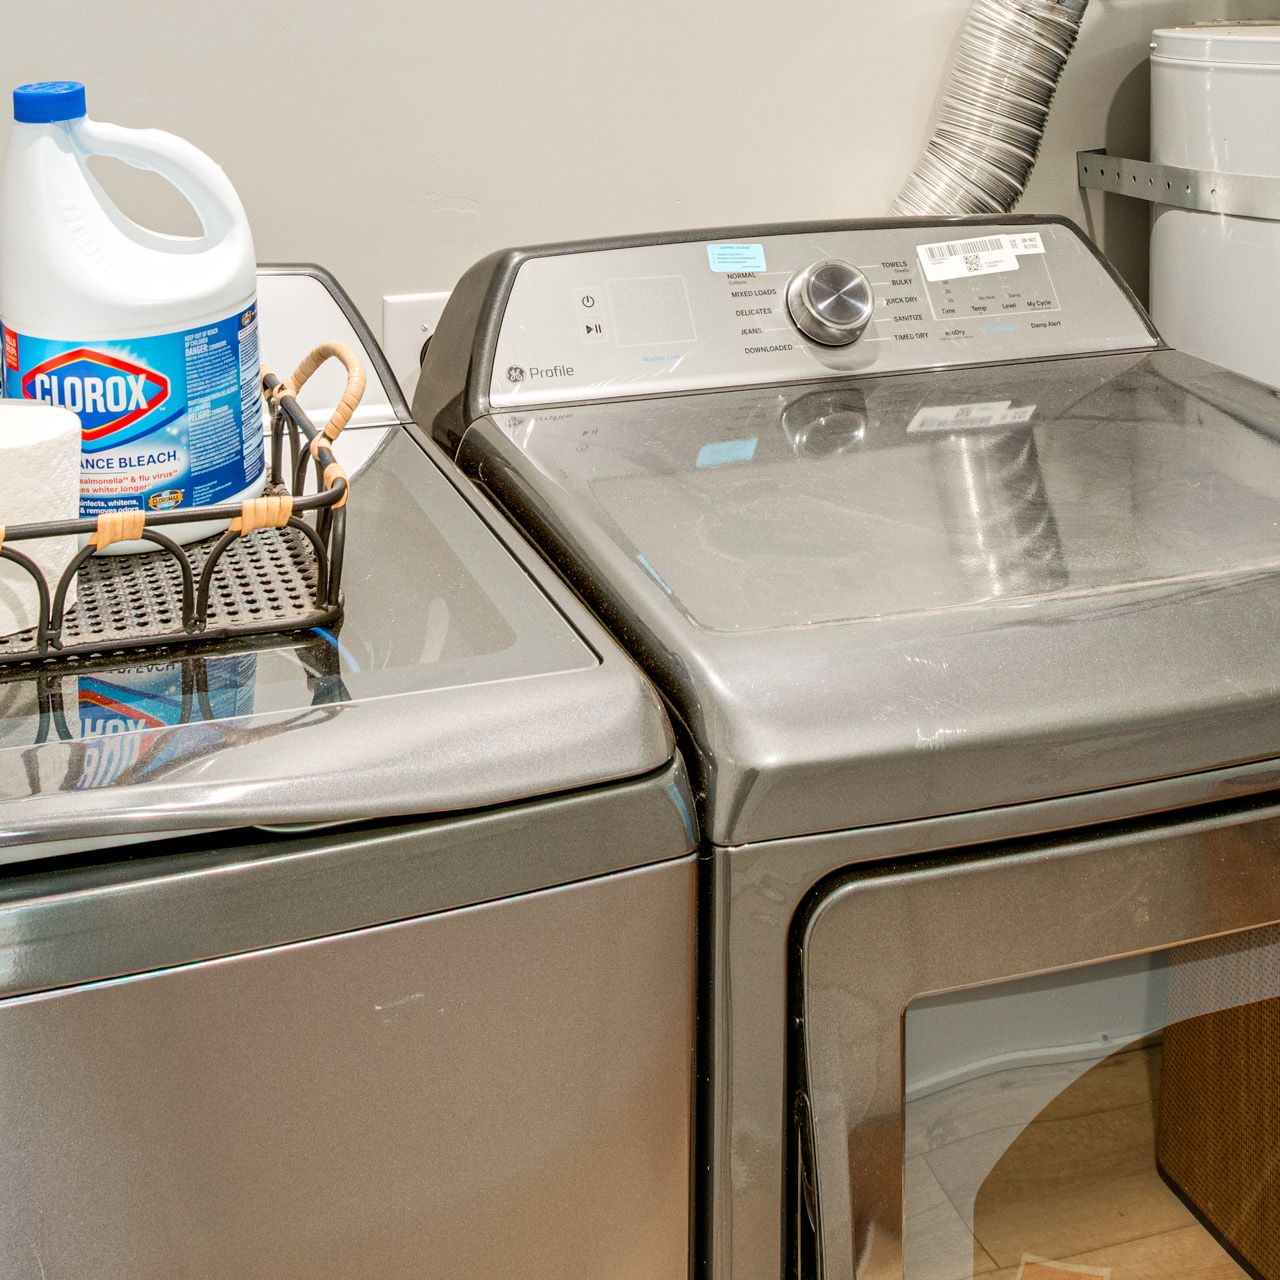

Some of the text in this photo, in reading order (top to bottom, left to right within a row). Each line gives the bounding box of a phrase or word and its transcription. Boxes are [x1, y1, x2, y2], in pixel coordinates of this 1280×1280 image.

[881, 261, 908, 269] TOWELS
[727, 272, 756, 280] NORMAL
[891, 278, 913, 286] BULKY
[731, 288, 777, 298] MIXED LOADS
[1026, 299, 1051, 308] My Cycle
[736, 308, 772, 317] DELICATES
[894, 314, 923, 322] SANITIZE
[1031, 320, 1061, 329] Damp Alert
[741, 327, 762, 335] JEANS
[945, 329, 965, 337] ecoDry
[894, 333, 915, 341] TIMED
[185, 344, 209, 357] DANGER:
[745, 344, 793, 354] DOWNLOADED
[529, 365, 574, 380] Profile
[35, 373, 148, 414] CLOROX
[118, 450, 177, 468] BLEACH
[139, 474, 150, 482] flu
[91, 484, 118, 494] whiter
[108, 499, 139, 507] whitens,
[86, 506, 118, 514] removes
